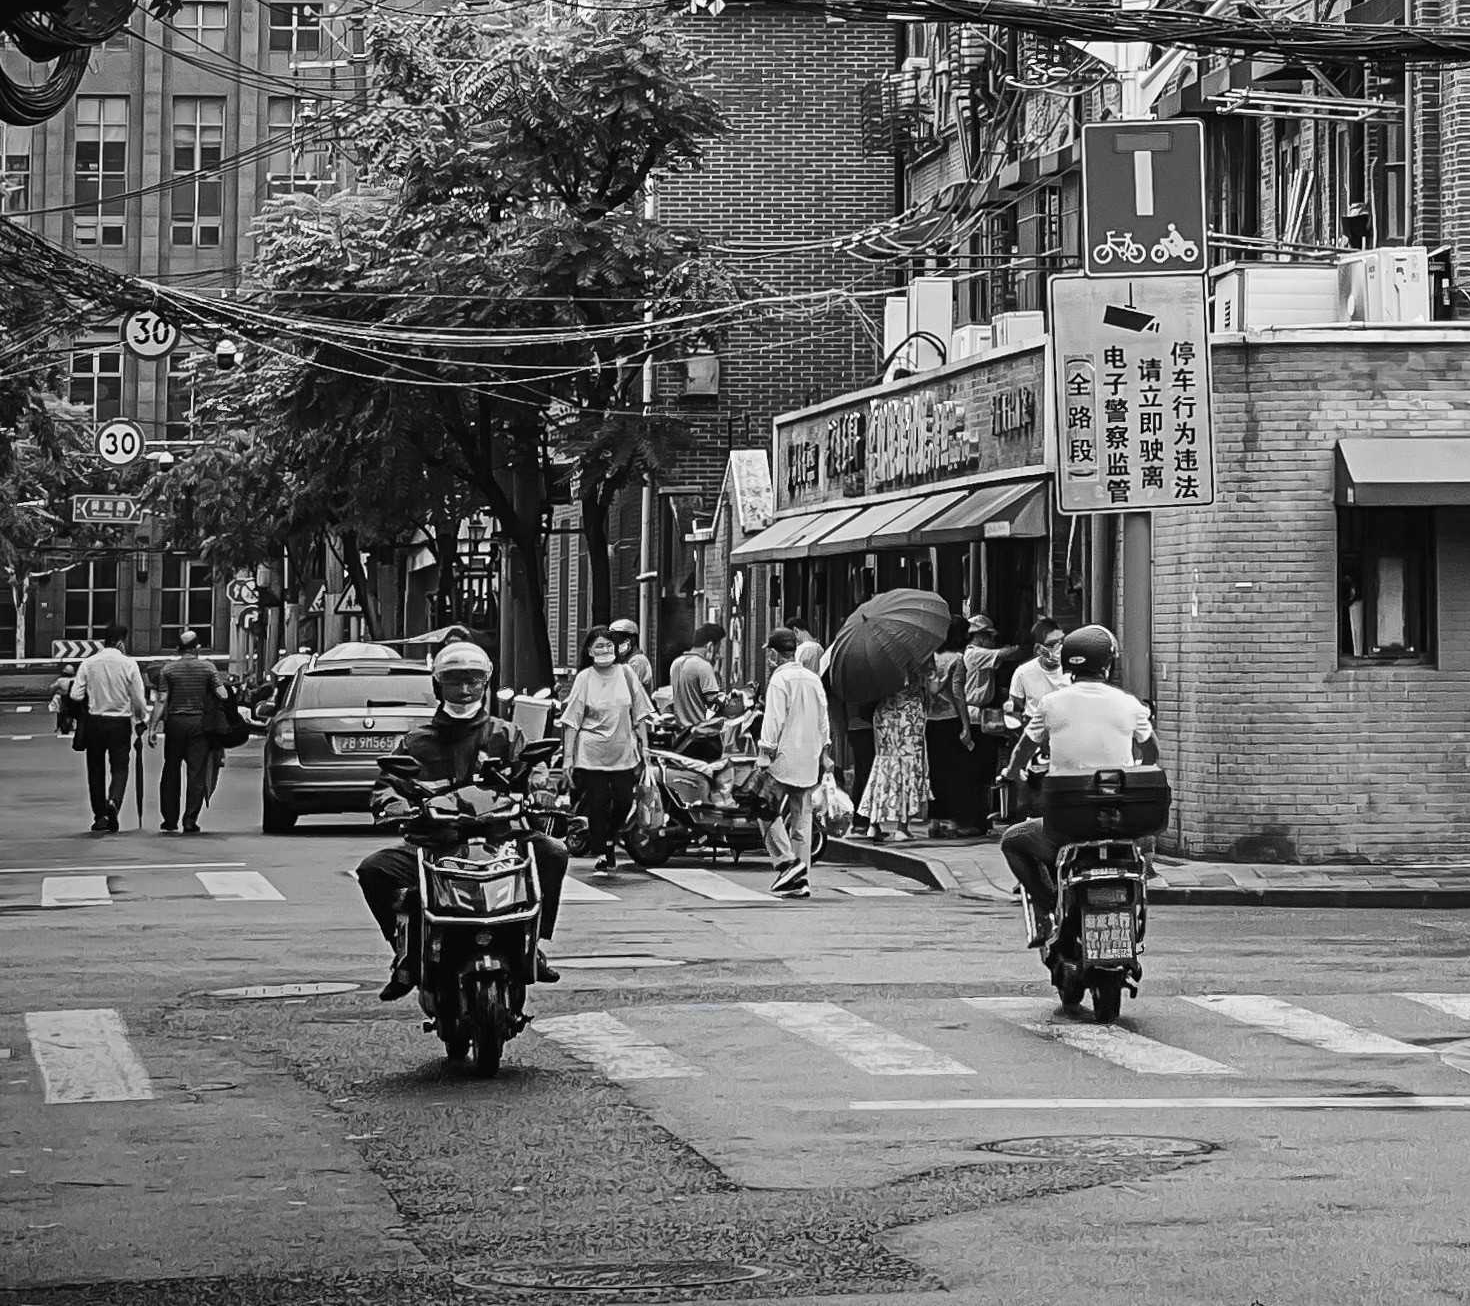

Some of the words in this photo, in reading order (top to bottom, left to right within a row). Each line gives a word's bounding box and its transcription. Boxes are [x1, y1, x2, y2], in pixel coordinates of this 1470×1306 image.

[133, 317, 170, 344] 30
[104, 432, 134, 455] 30
[1103, 345, 1131, 504] 电子警察监管
[1137, 357, 1165, 489] 请立即驶离
[1170, 341, 1200, 499] 停车行为违法
